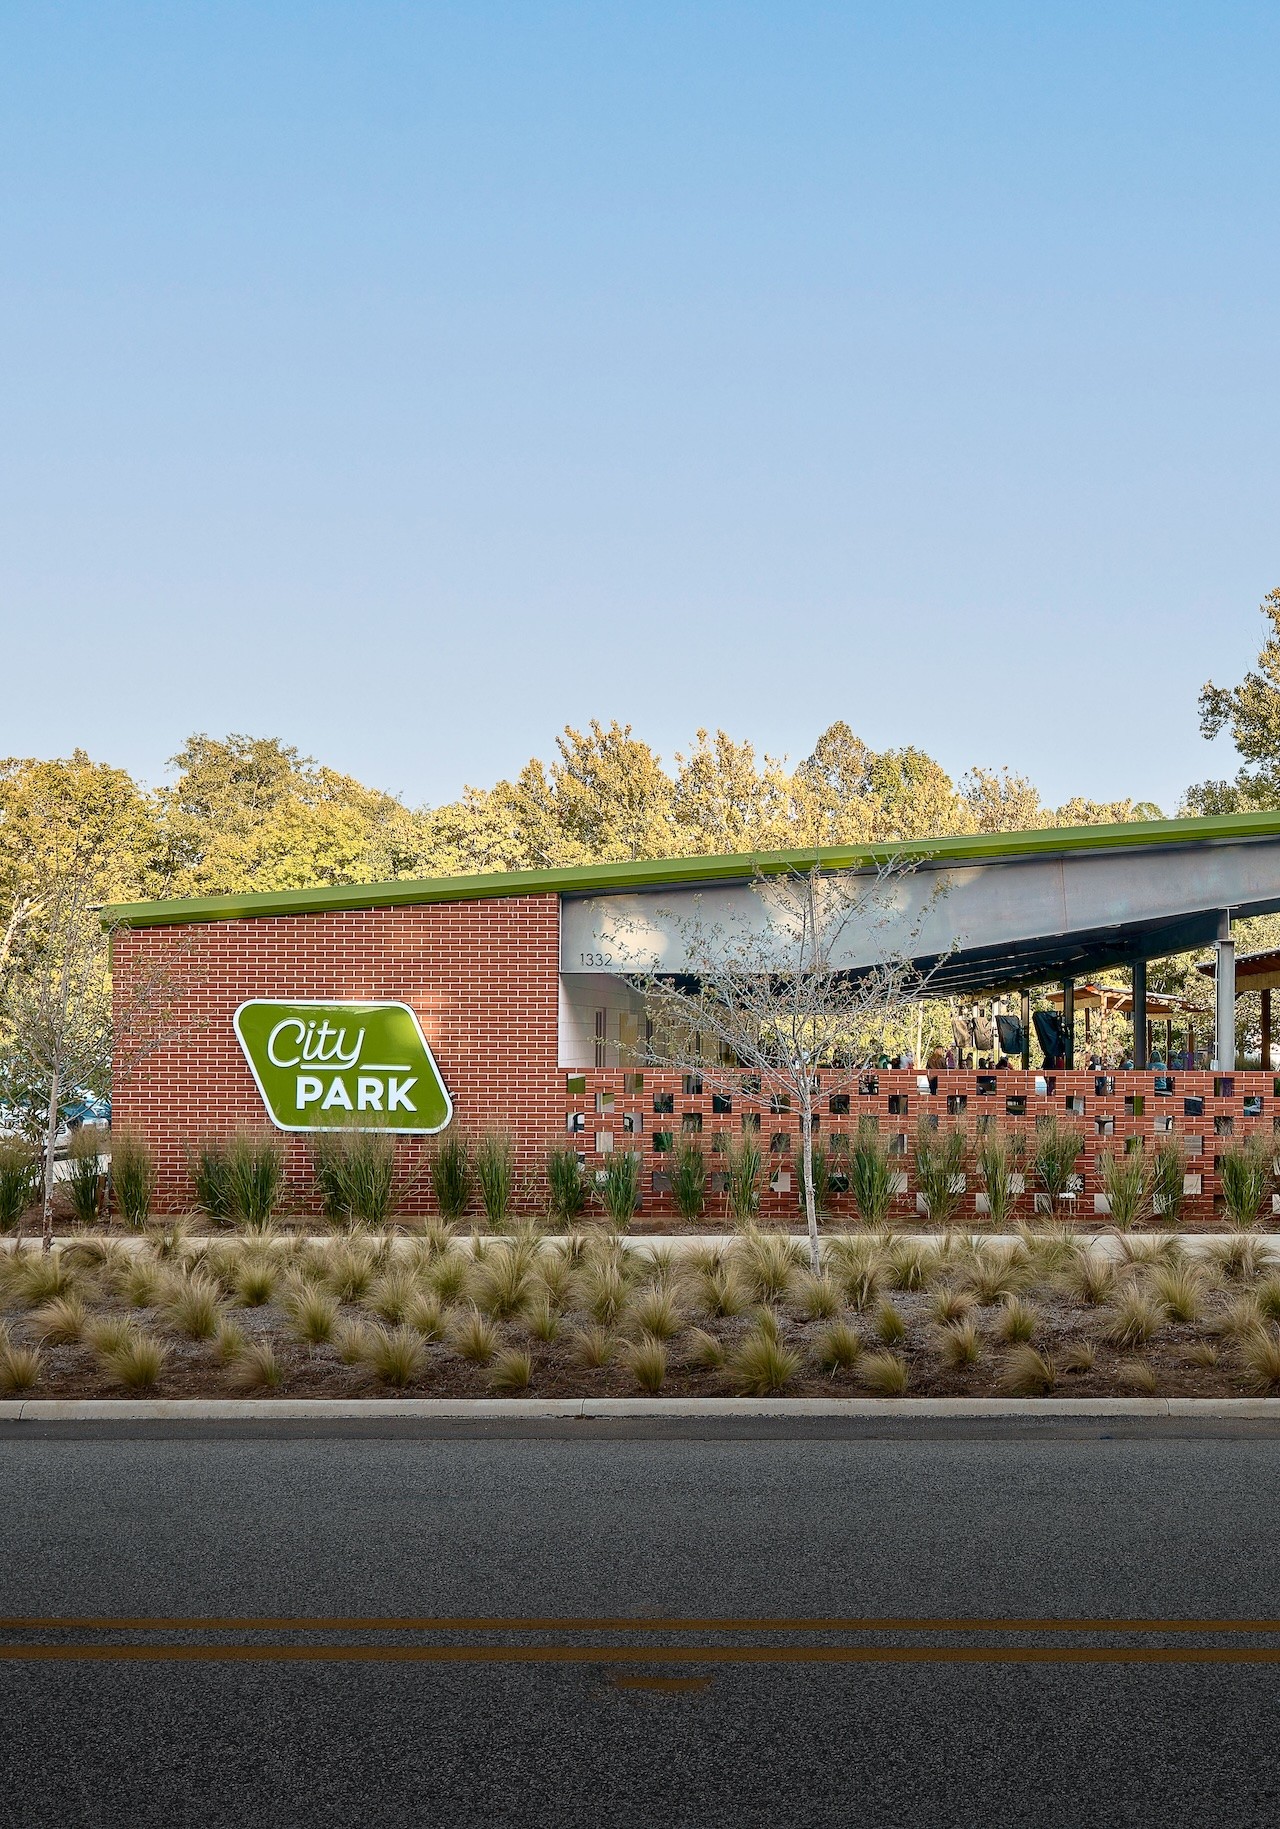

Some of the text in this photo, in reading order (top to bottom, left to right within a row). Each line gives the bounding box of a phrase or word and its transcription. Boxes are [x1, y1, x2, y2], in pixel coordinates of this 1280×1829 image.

[580, 953, 613, 967] 1332
[267, 1017, 366, 1071] City
[295, 1075, 419, 1112] PARK
